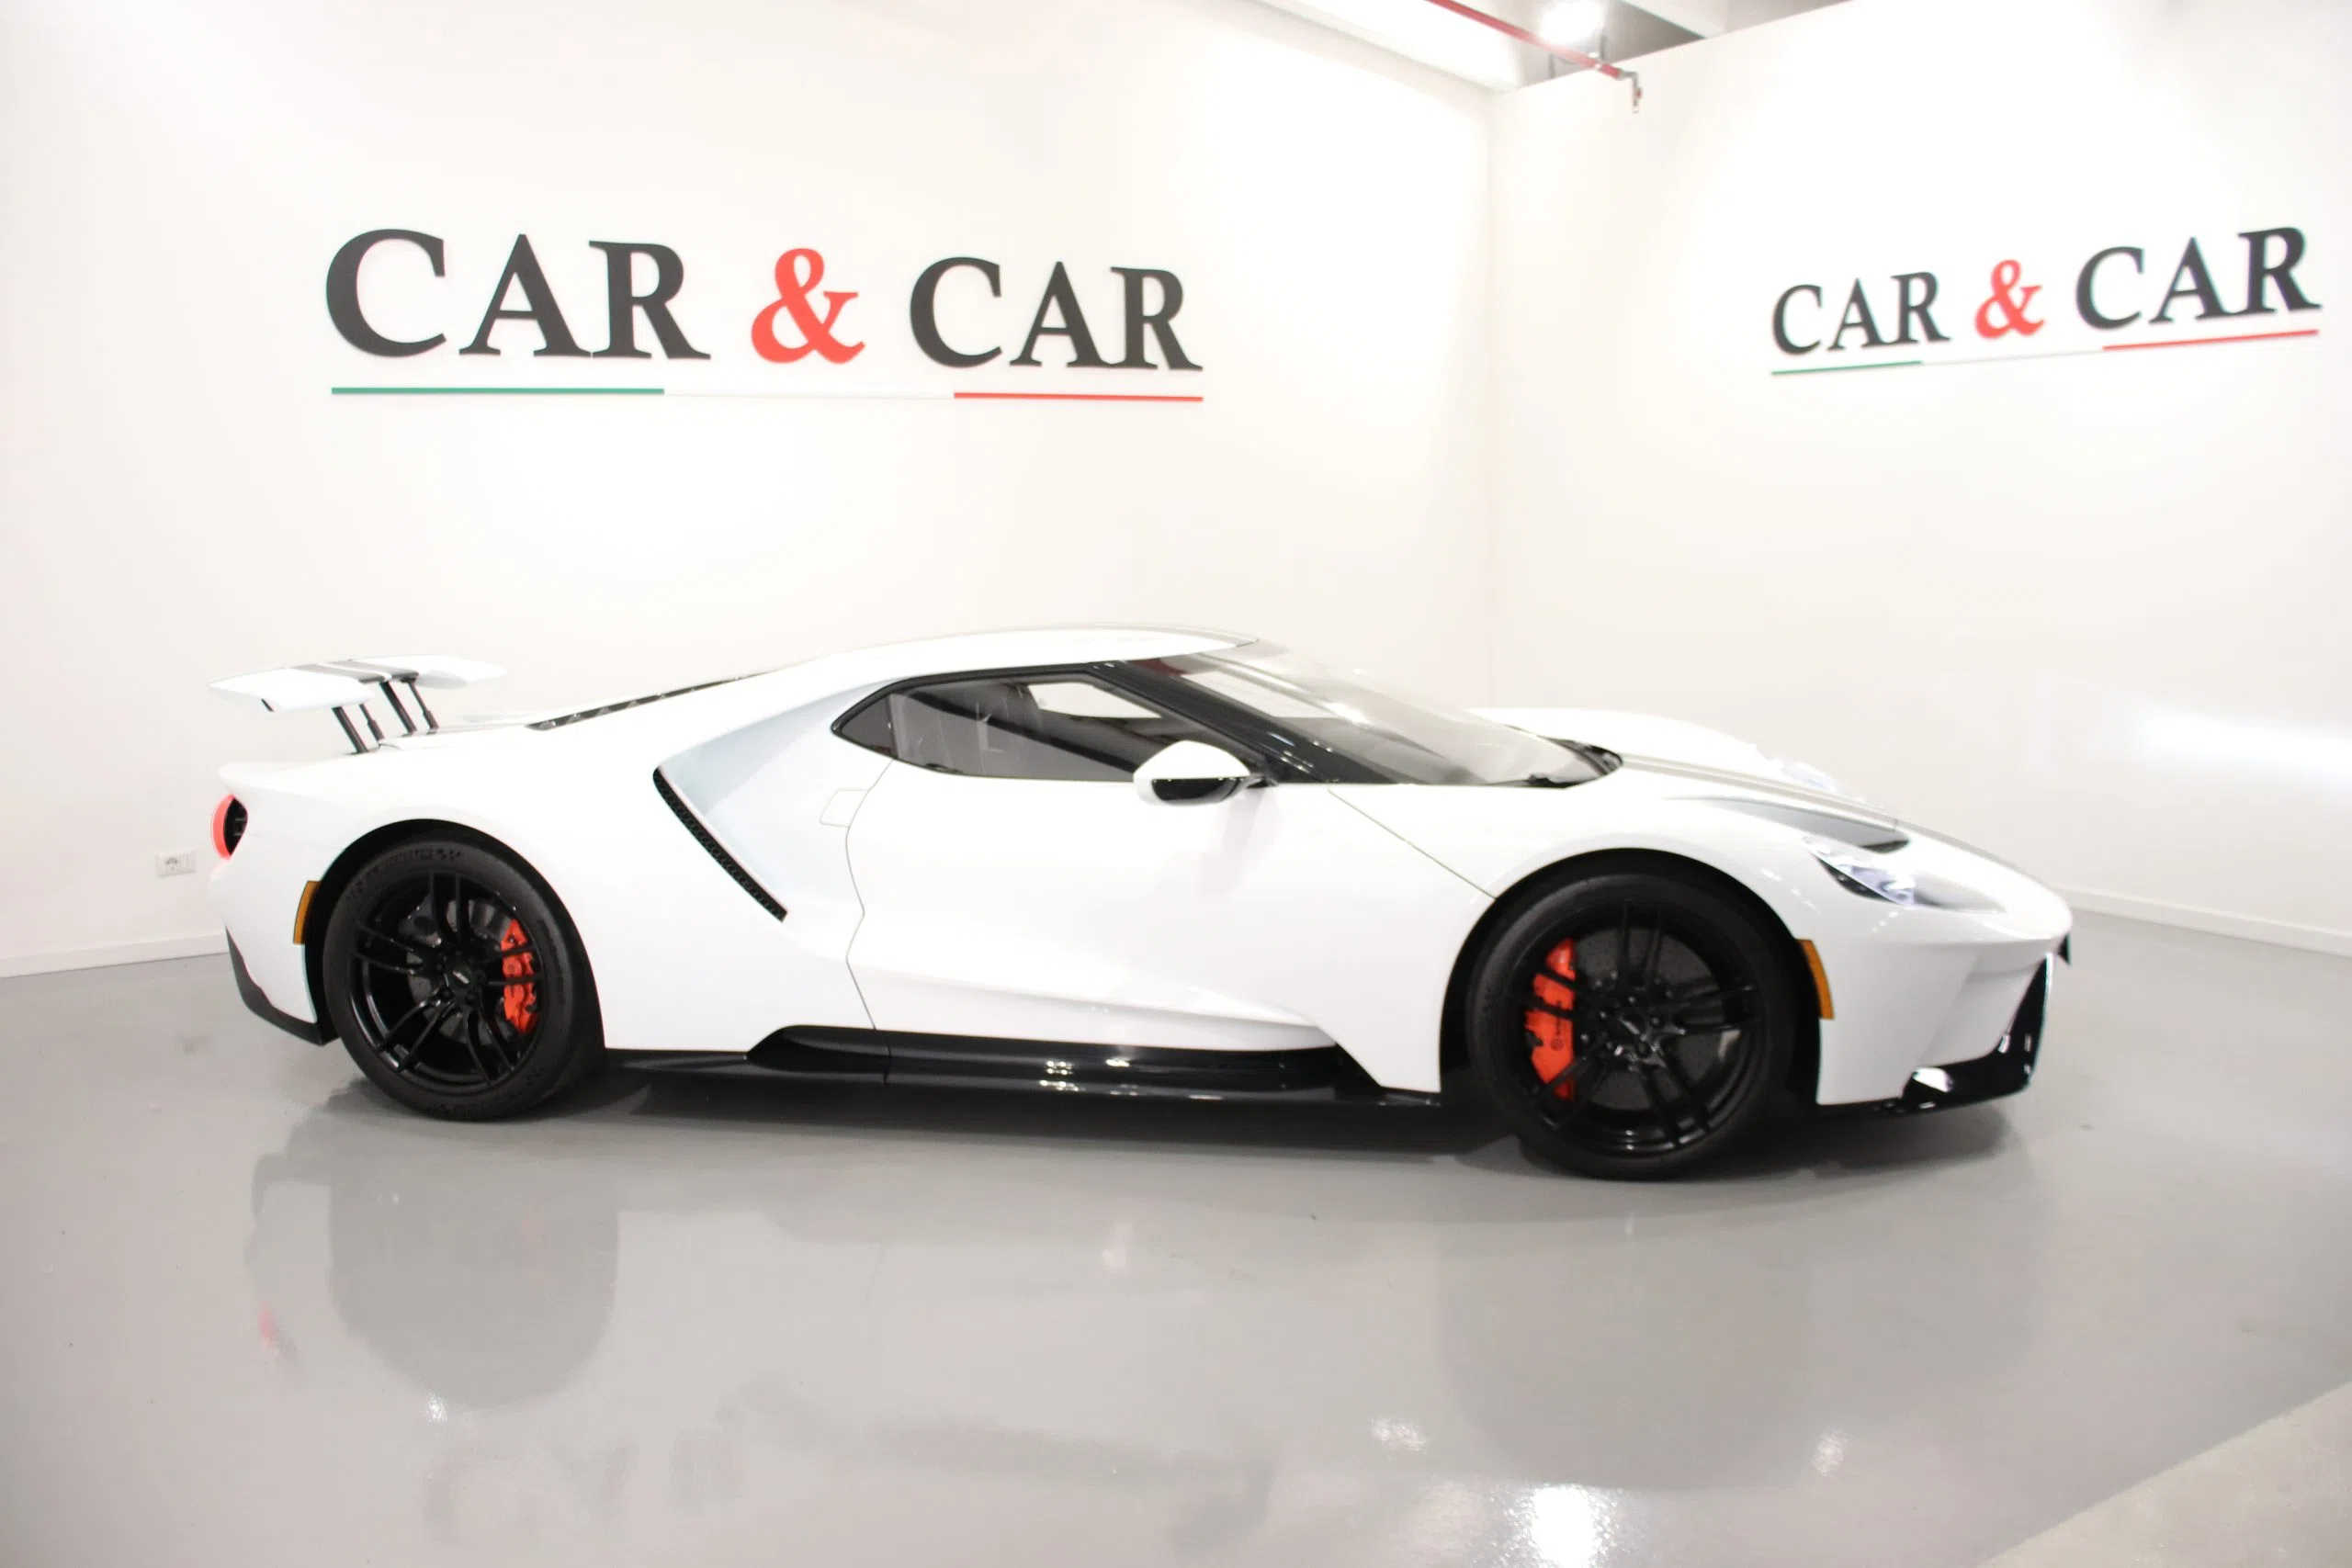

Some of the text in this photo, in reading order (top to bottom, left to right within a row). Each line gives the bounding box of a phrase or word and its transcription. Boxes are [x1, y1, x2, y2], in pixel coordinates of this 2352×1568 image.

[325, 229, 1204, 371] CAR & CAR
[1772, 226, 2322, 355] CAR & CAR
